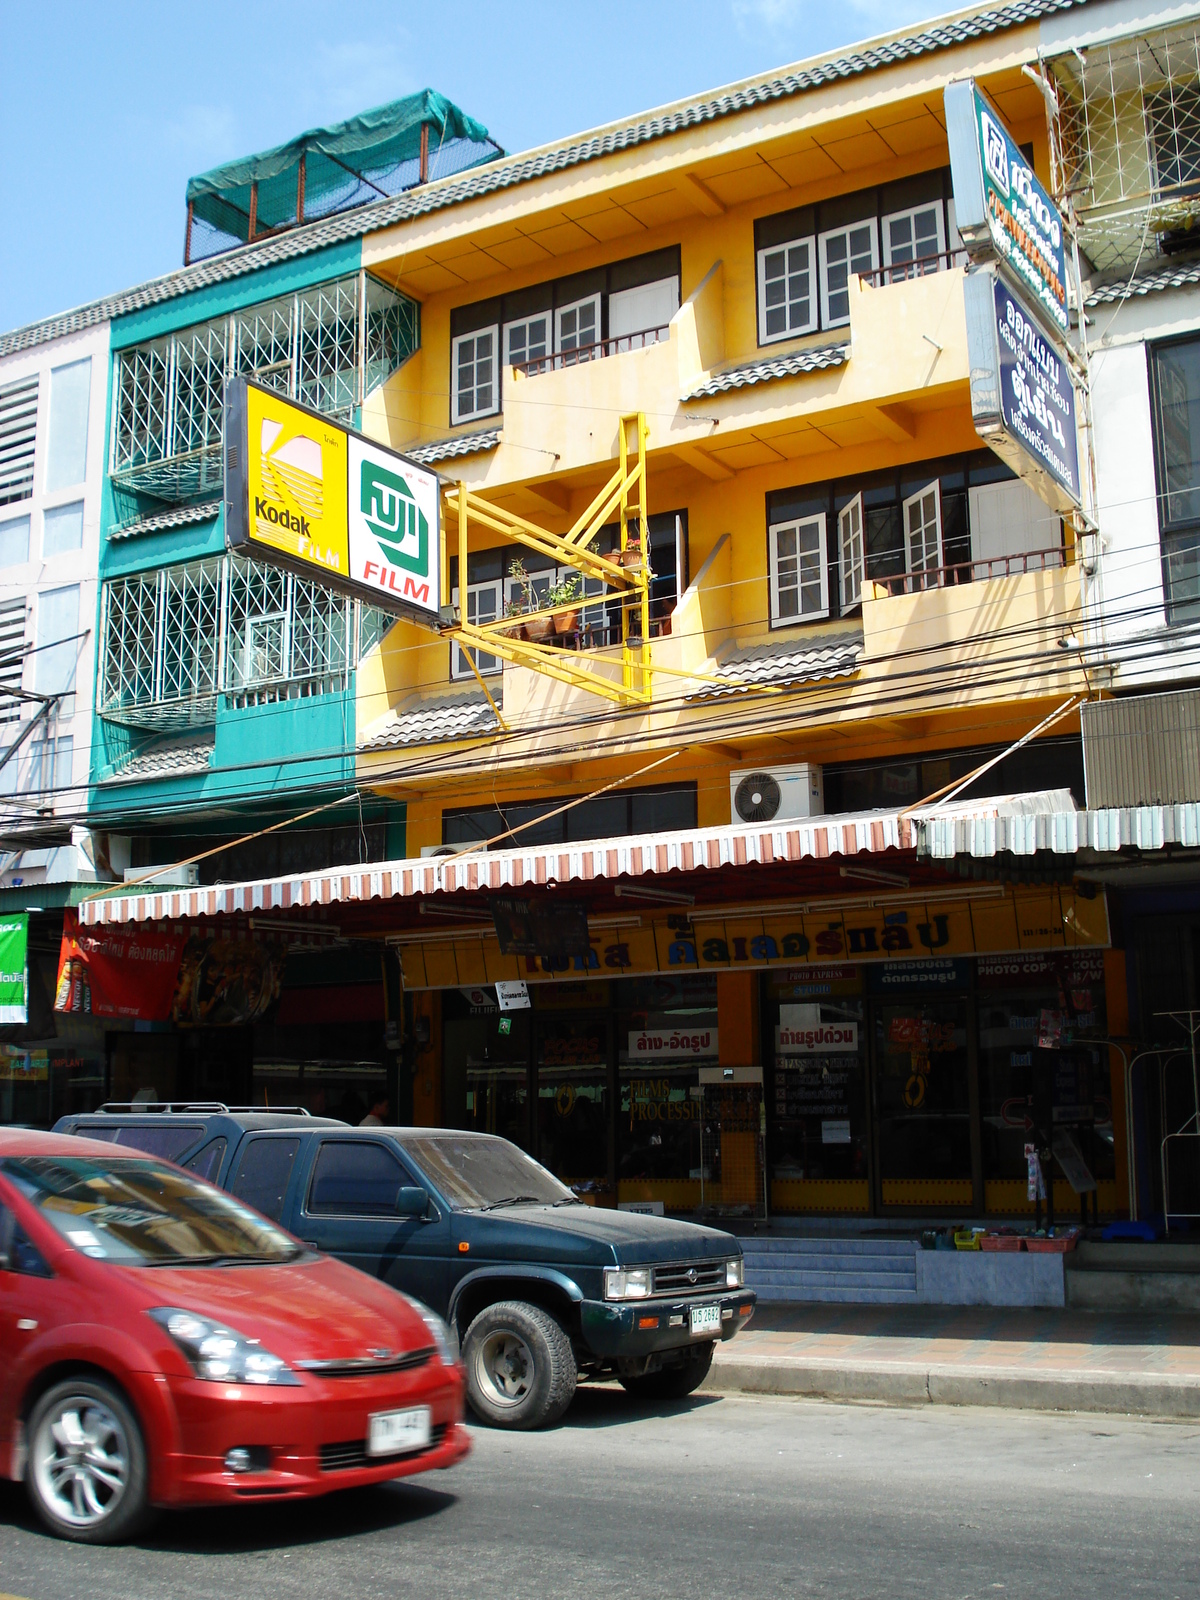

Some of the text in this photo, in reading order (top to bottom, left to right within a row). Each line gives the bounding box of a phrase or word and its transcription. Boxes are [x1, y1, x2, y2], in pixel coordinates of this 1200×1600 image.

[1006, 300, 1060, 385] ออกแบบ
[1011, 361, 1066, 449] ตู้เย็น
[255, 496, 312, 538] Kodak
[361, 459, 429, 578] FUJI
[297, 536, 340, 569] FILM
[363, 561, 430, 603] FILM
[978, 961, 1056, 976] PHOTO COPY
[1072, 958, 1104, 970] COLO
[558, 982, 587, 993] Kodak
[793, 984, 831, 995] STUDIO
[780, 1026, 853, 1049] ถ่ายรูปด่วน
[888, 1022, 956, 1042] FOCUS
[544, 1036, 600, 1055] FOCUS
[10, 1058, 50, 1069] ZAHARZT
[629, 1078, 671, 1099] FILMS
[704, 1307, 719, 1322] 2692
